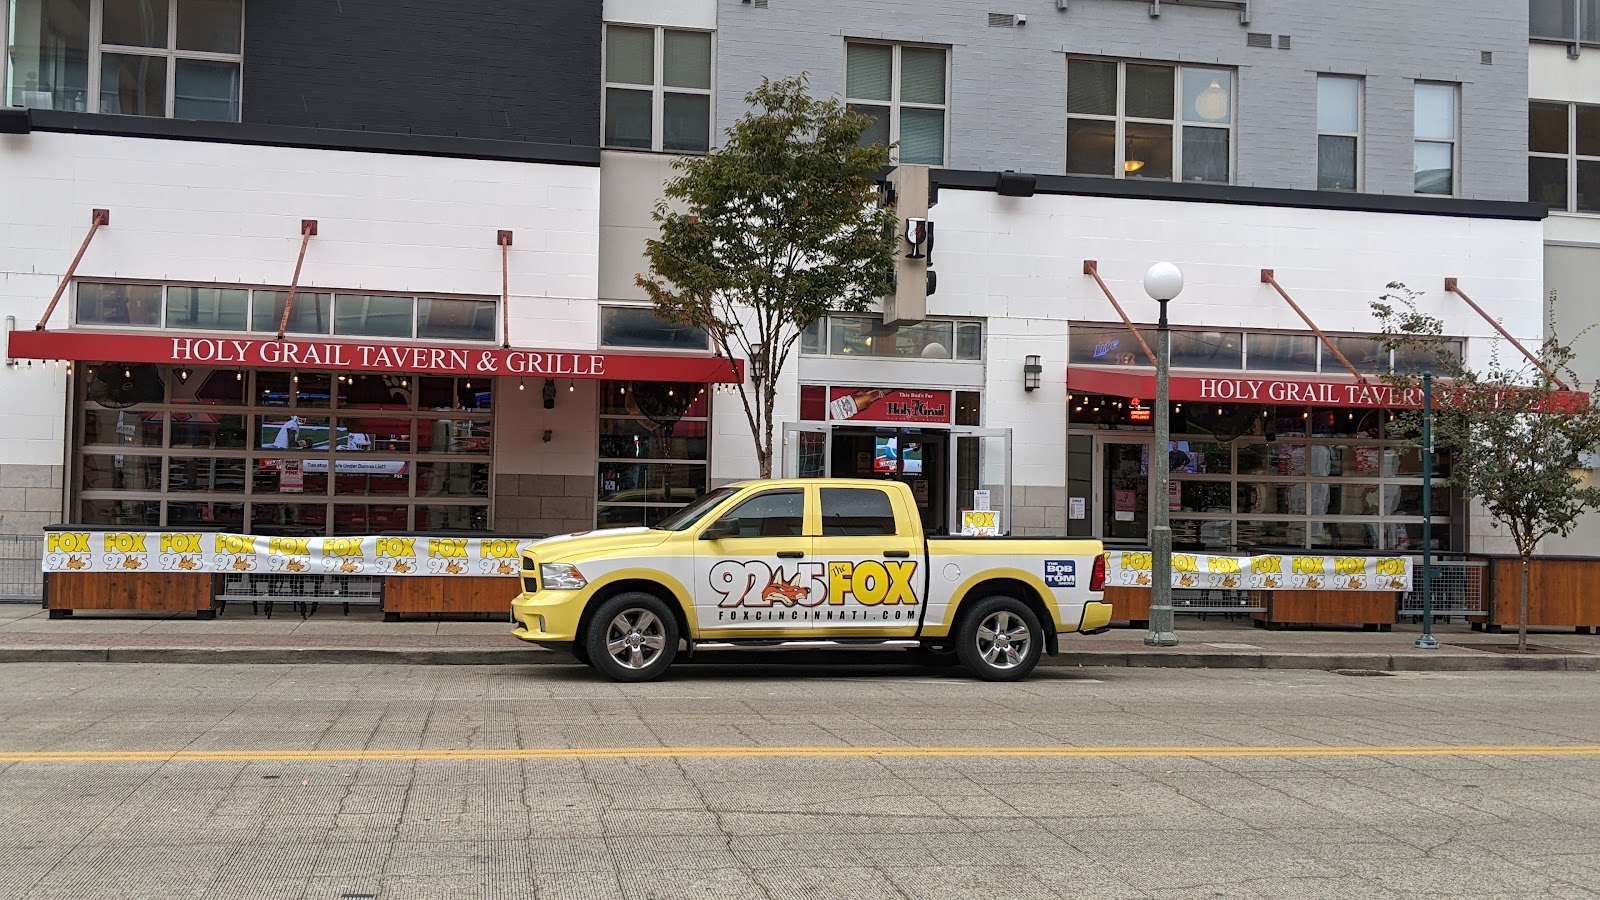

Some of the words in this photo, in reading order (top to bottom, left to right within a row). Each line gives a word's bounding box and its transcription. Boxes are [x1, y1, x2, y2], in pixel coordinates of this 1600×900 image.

[171, 338, 253, 362] HOLY
[260, 341, 350, 365] GRAIL
[357, 345, 469, 370] TAVERN
[476, 351, 498, 371] &
[506, 351, 605, 375] GRILLE
[1200, 379, 1263, 399] HOLY
[1269, 381, 1340, 402] GRAIL
[887, 401, 912, 418] Holy
[919, 401, 946, 417] Grail
[965, 512, 995, 527] FOX
[48, 532, 91, 553] FOX
[104, 532, 147, 553] FOX
[160, 532, 202, 553] FOX
[215, 533, 256, 554] FOX
[269, 537, 310, 556] FOX
[323, 537, 364, 556] FOX
[376, 537, 416, 558] FOX
[428, 538, 468, 558] FOX
[480, 538, 520, 559] FOX
[831, 564, 847, 578] The
[1207, 556, 1242, 573] FOX
[1250, 556, 1282, 574] FOX
[1292, 556, 1325, 575] FOX
[1334, 557, 1366, 575] FOX
[1376, 557, 1407, 575] FOX
[709, 560, 828, 608] 925
[828, 560, 919, 606] FOX
[718, 610, 915, 620] FOXCINCINNATI.COM
